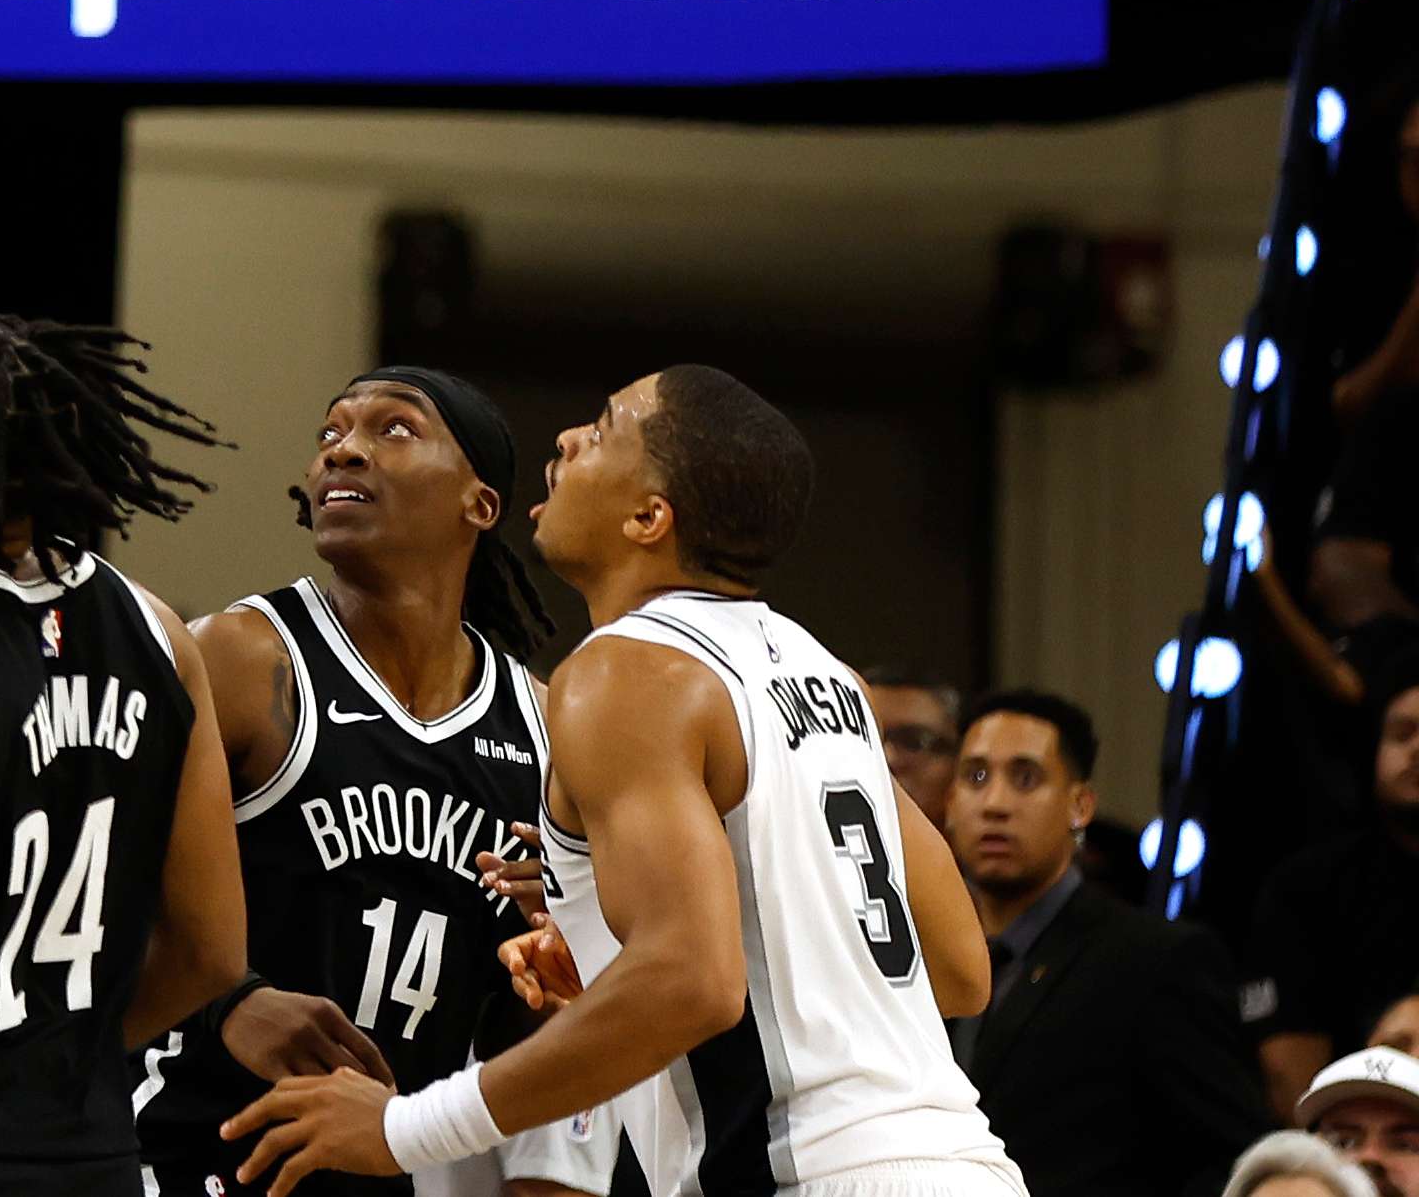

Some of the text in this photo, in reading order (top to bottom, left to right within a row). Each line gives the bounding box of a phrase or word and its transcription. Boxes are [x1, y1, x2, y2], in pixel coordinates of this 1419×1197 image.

[474, 736, 533, 765] All In Won
[819, 779, 921, 989] 3
[355, 897, 448, 1041] 14
